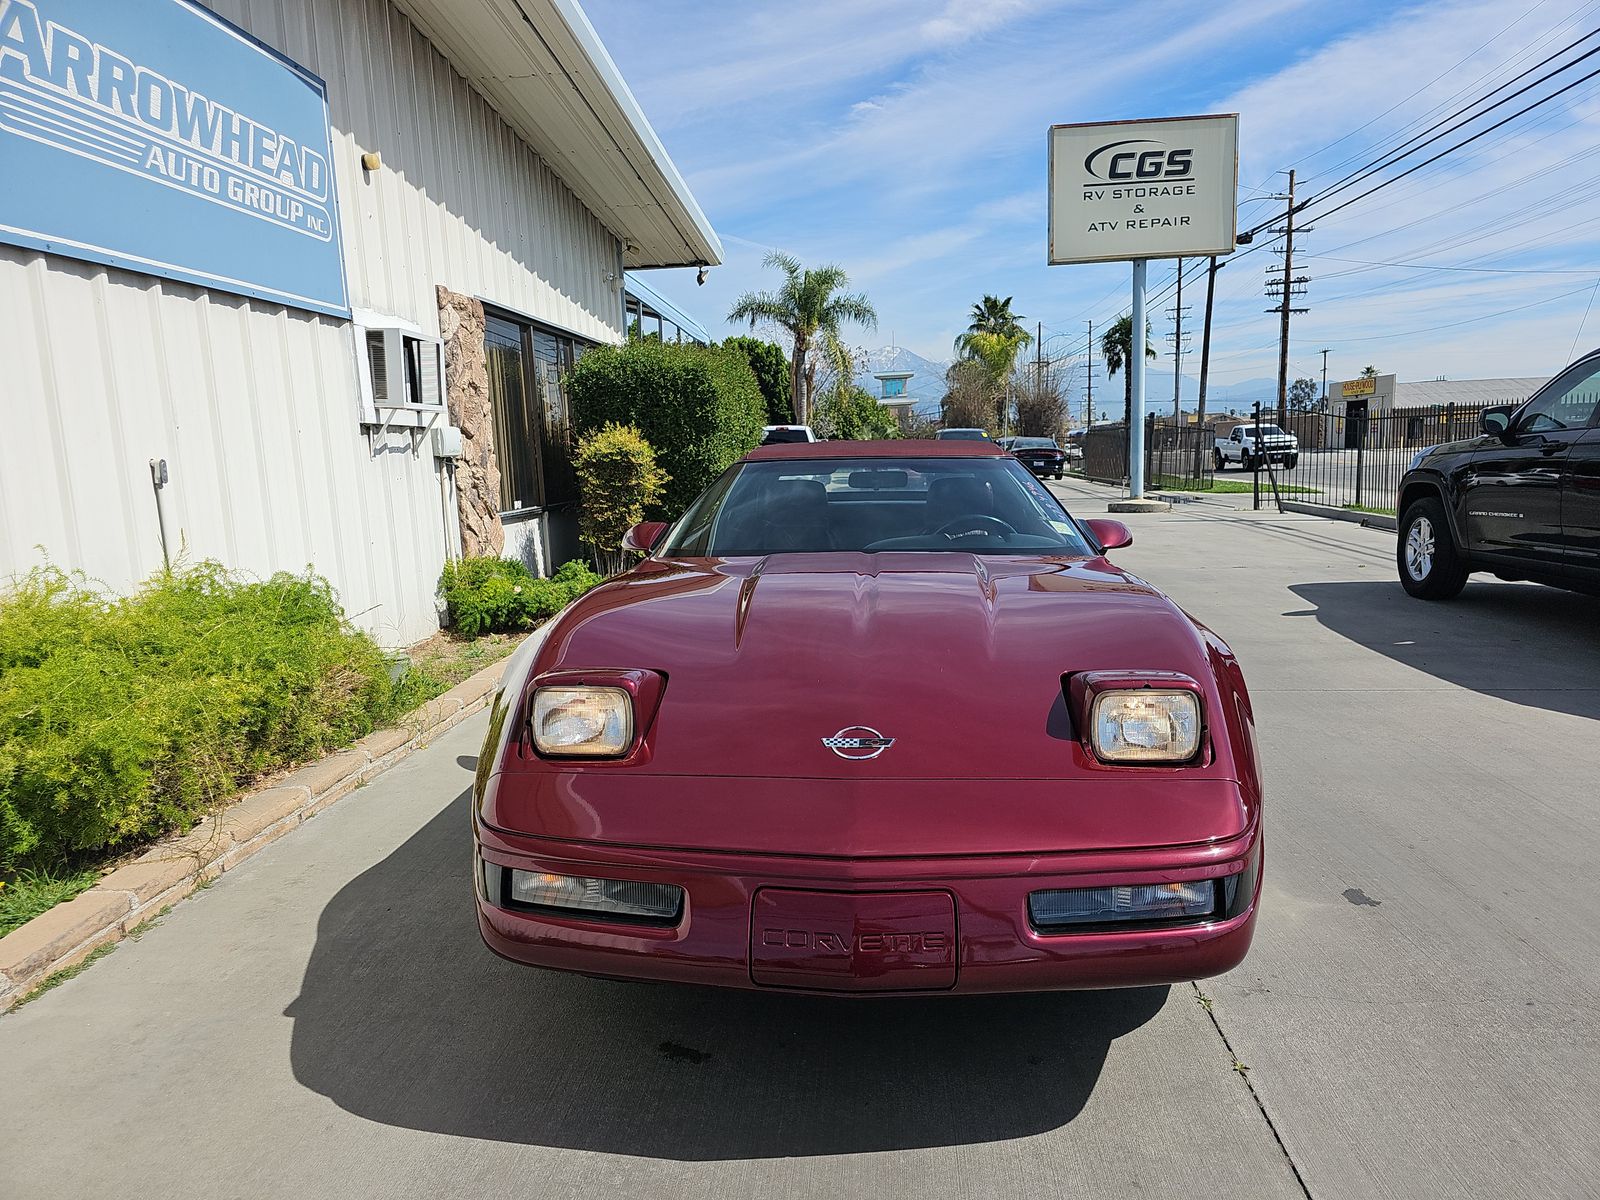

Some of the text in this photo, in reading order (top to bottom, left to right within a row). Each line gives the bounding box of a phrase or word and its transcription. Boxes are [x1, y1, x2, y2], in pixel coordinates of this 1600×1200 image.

[0, 0, 329, 203] ARROWHEAD
[1108, 148, 1194, 181] CGS
[145, 145, 328, 235] AUTO GROUP INC.
[1083, 185, 1196, 201] RV STORAGE
[1133, 204, 1144, 213] &
[1087, 215, 1191, 233] ATV REPAIR
[763, 928, 945, 952] CORVETTE
